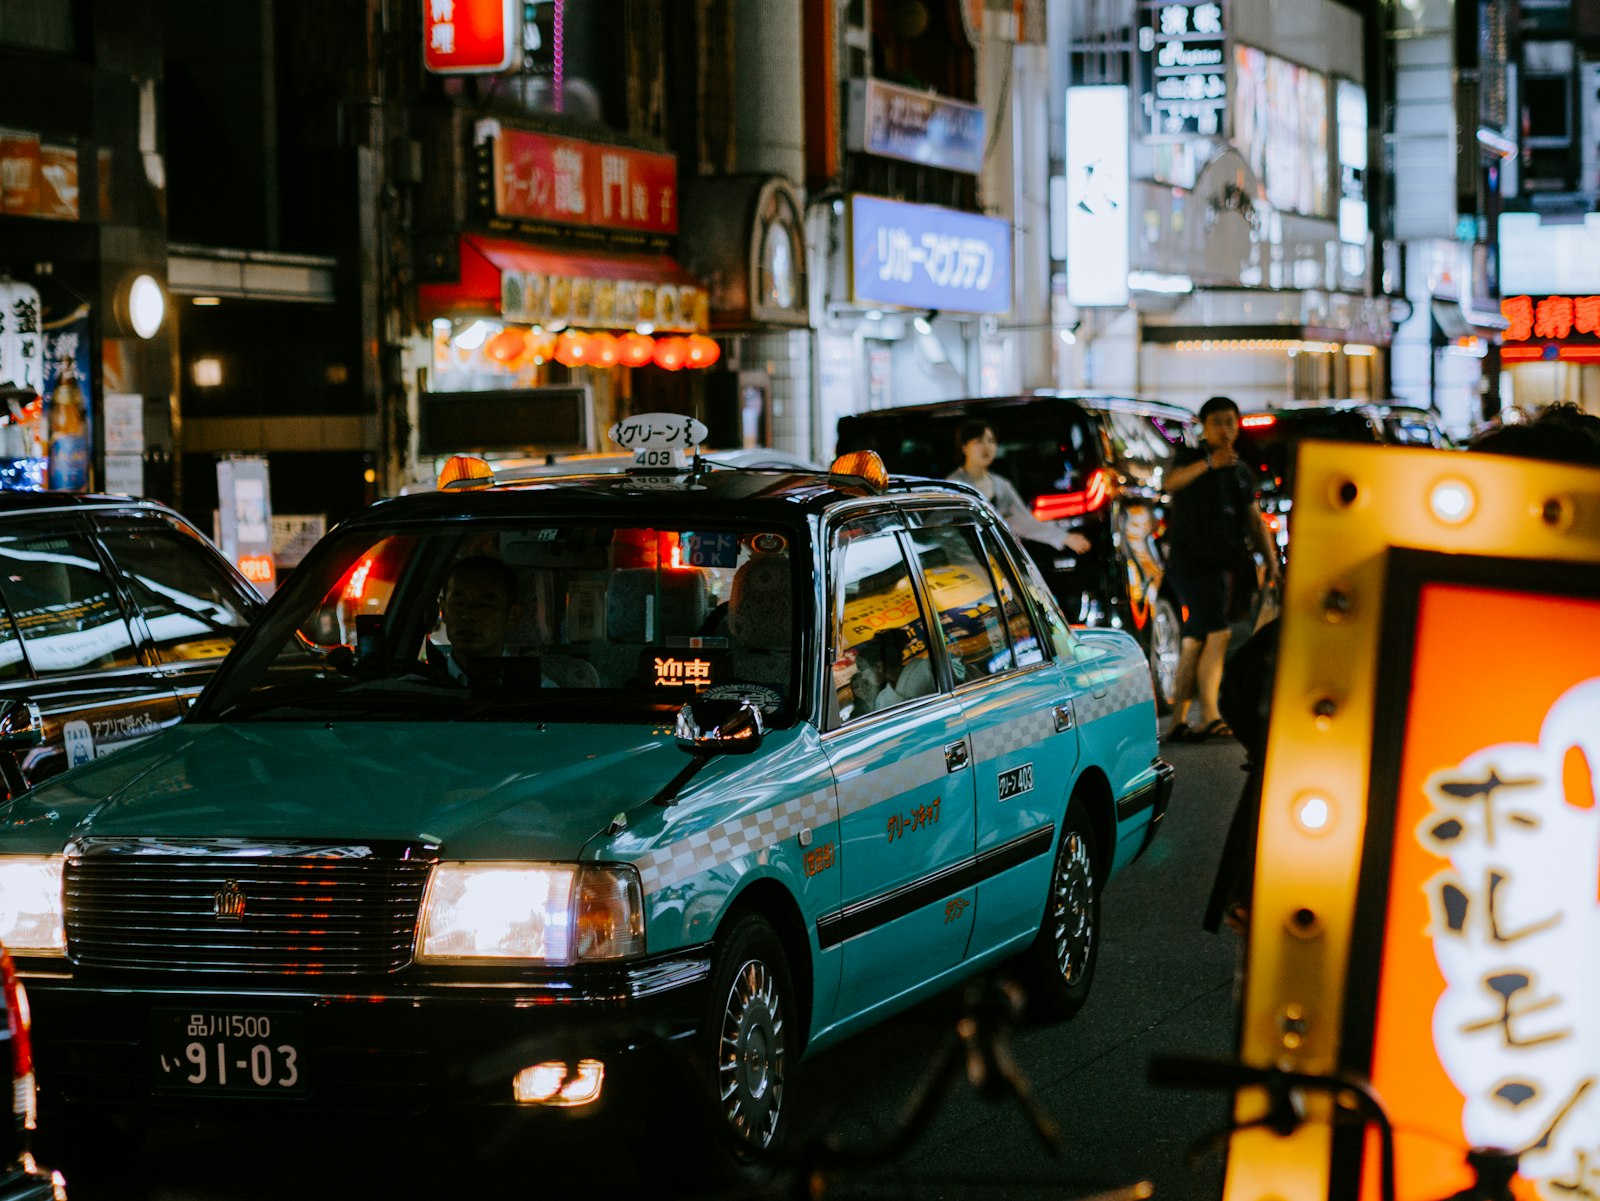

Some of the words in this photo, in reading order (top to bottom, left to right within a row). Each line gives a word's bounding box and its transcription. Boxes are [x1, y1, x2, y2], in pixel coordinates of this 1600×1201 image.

[623, 425, 680, 444] グリーン
[636, 451, 671, 466] 403
[654, 657, 712, 692] 迎車
[67, 728, 88, 741] TAXI
[999, 773, 1017, 797] グリーン
[1018, 766, 1034, 792] 403
[944, 897, 971, 925] タクシー
[160, 1053, 181, 1074] い
[185, 1041, 298, 1087] 91-03
